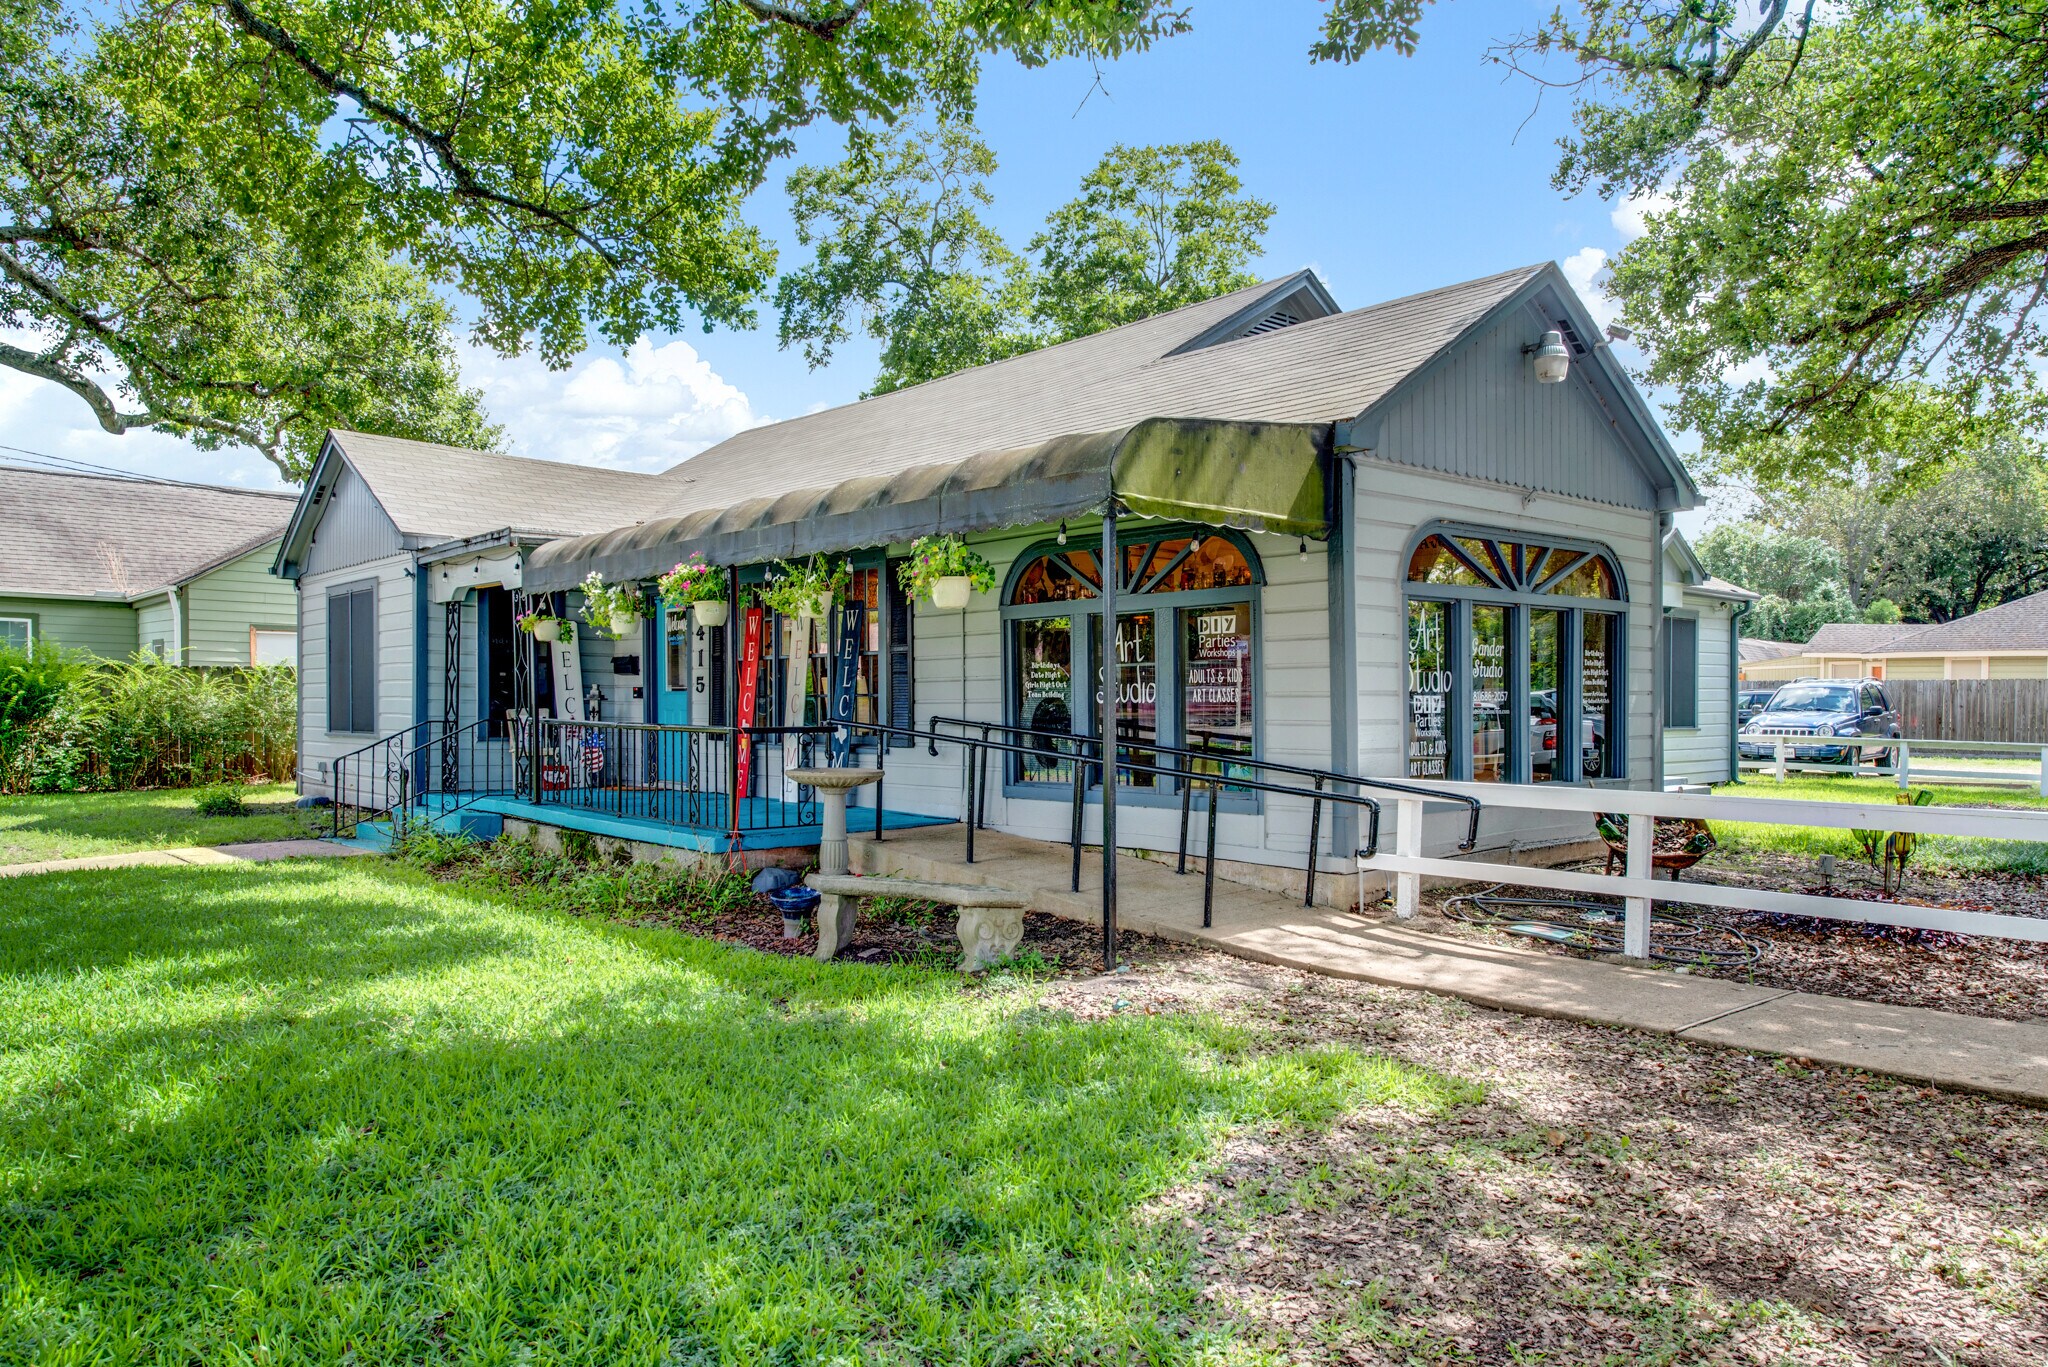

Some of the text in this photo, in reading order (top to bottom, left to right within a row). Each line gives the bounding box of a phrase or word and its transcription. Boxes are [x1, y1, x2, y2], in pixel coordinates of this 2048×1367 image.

[1198, 615, 1236, 634] DIY
[1409, 608, 1442, 651] Art
[1115, 622, 1145, 662] Art
[1199, 634, 1236, 648] Parties
[1472, 637, 1504, 657] Gander
[1199, 648, 1236, 659] Workshops
[1031, 660, 1060, 670] Birthdays
[1473, 658, 1503, 678] Studio
[1031, 671, 1061, 680] Date Night
[1189, 667, 1243, 683] ADULTS & KIDS
[831, 610, 859, 768] WELCM
[1040, 681, 1055, 690] Night
[1028, 690, 1065, 700] Team Building
[1193, 688, 1240, 703] ART CLASSES
[1413, 696, 1441, 713] DIY
[1415, 714, 1441, 728] Parties
[1414, 728, 1441, 738] Workshops
[1428, 744, 1434, 755] &
[1434, 740, 1447, 755] KIDS
[1410, 760, 1445, 776] ART CLASSES
